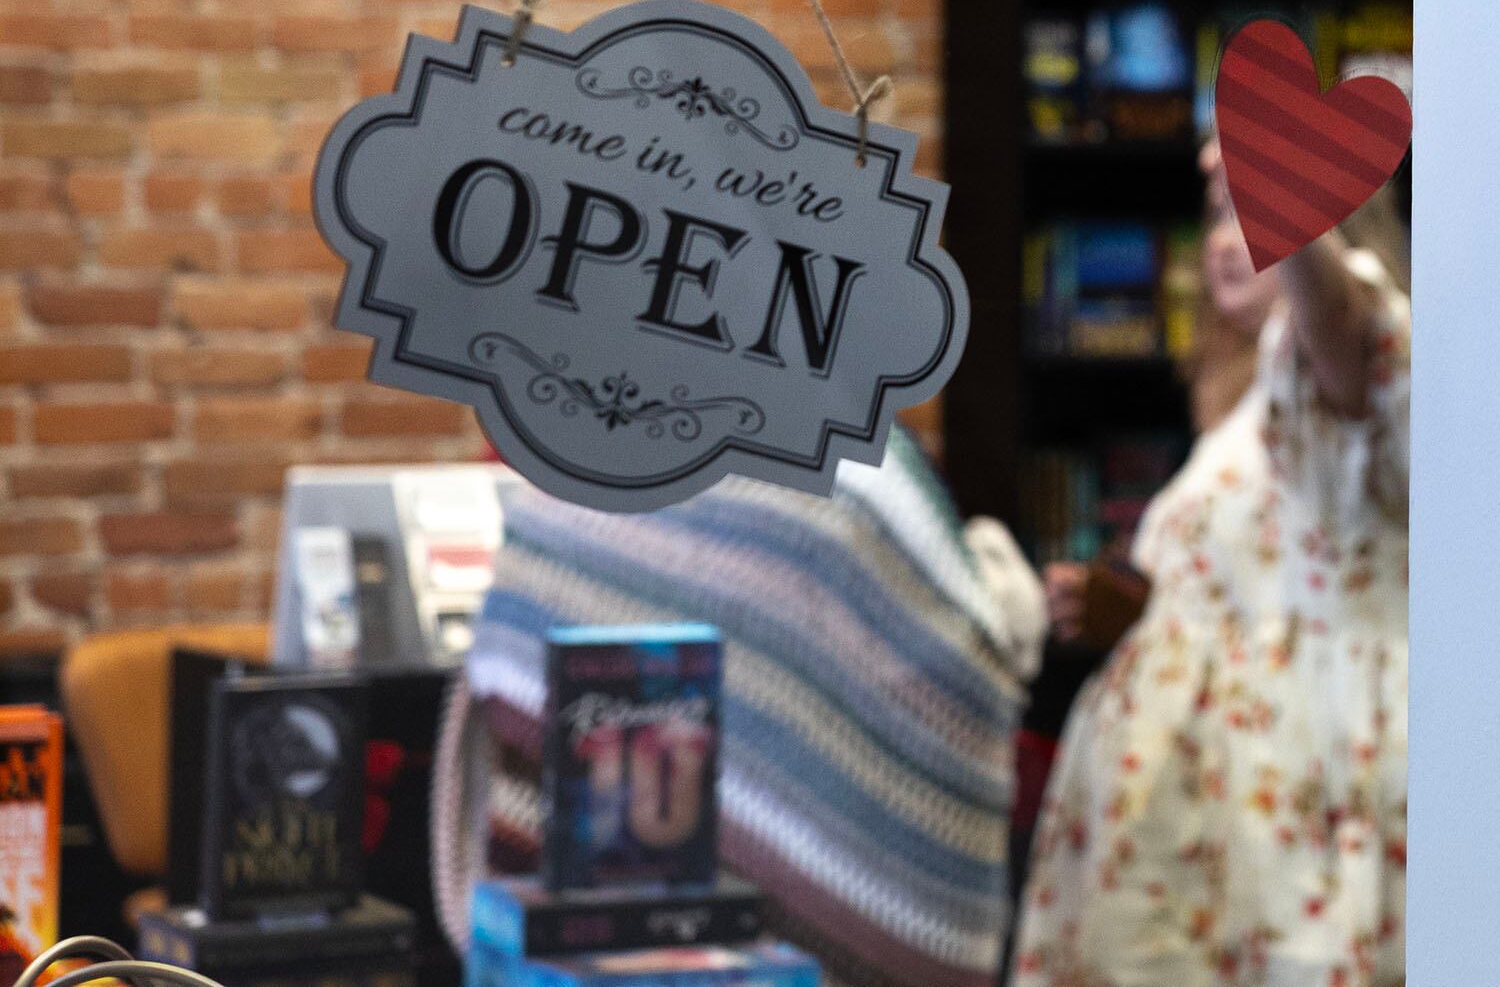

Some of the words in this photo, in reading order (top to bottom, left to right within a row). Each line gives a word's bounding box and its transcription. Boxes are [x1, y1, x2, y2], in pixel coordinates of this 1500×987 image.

[497, 107, 626, 160] come
[636, 136, 696, 192] in,
[717, 165, 845, 222] we're
[431, 157, 867, 378] OPEN
